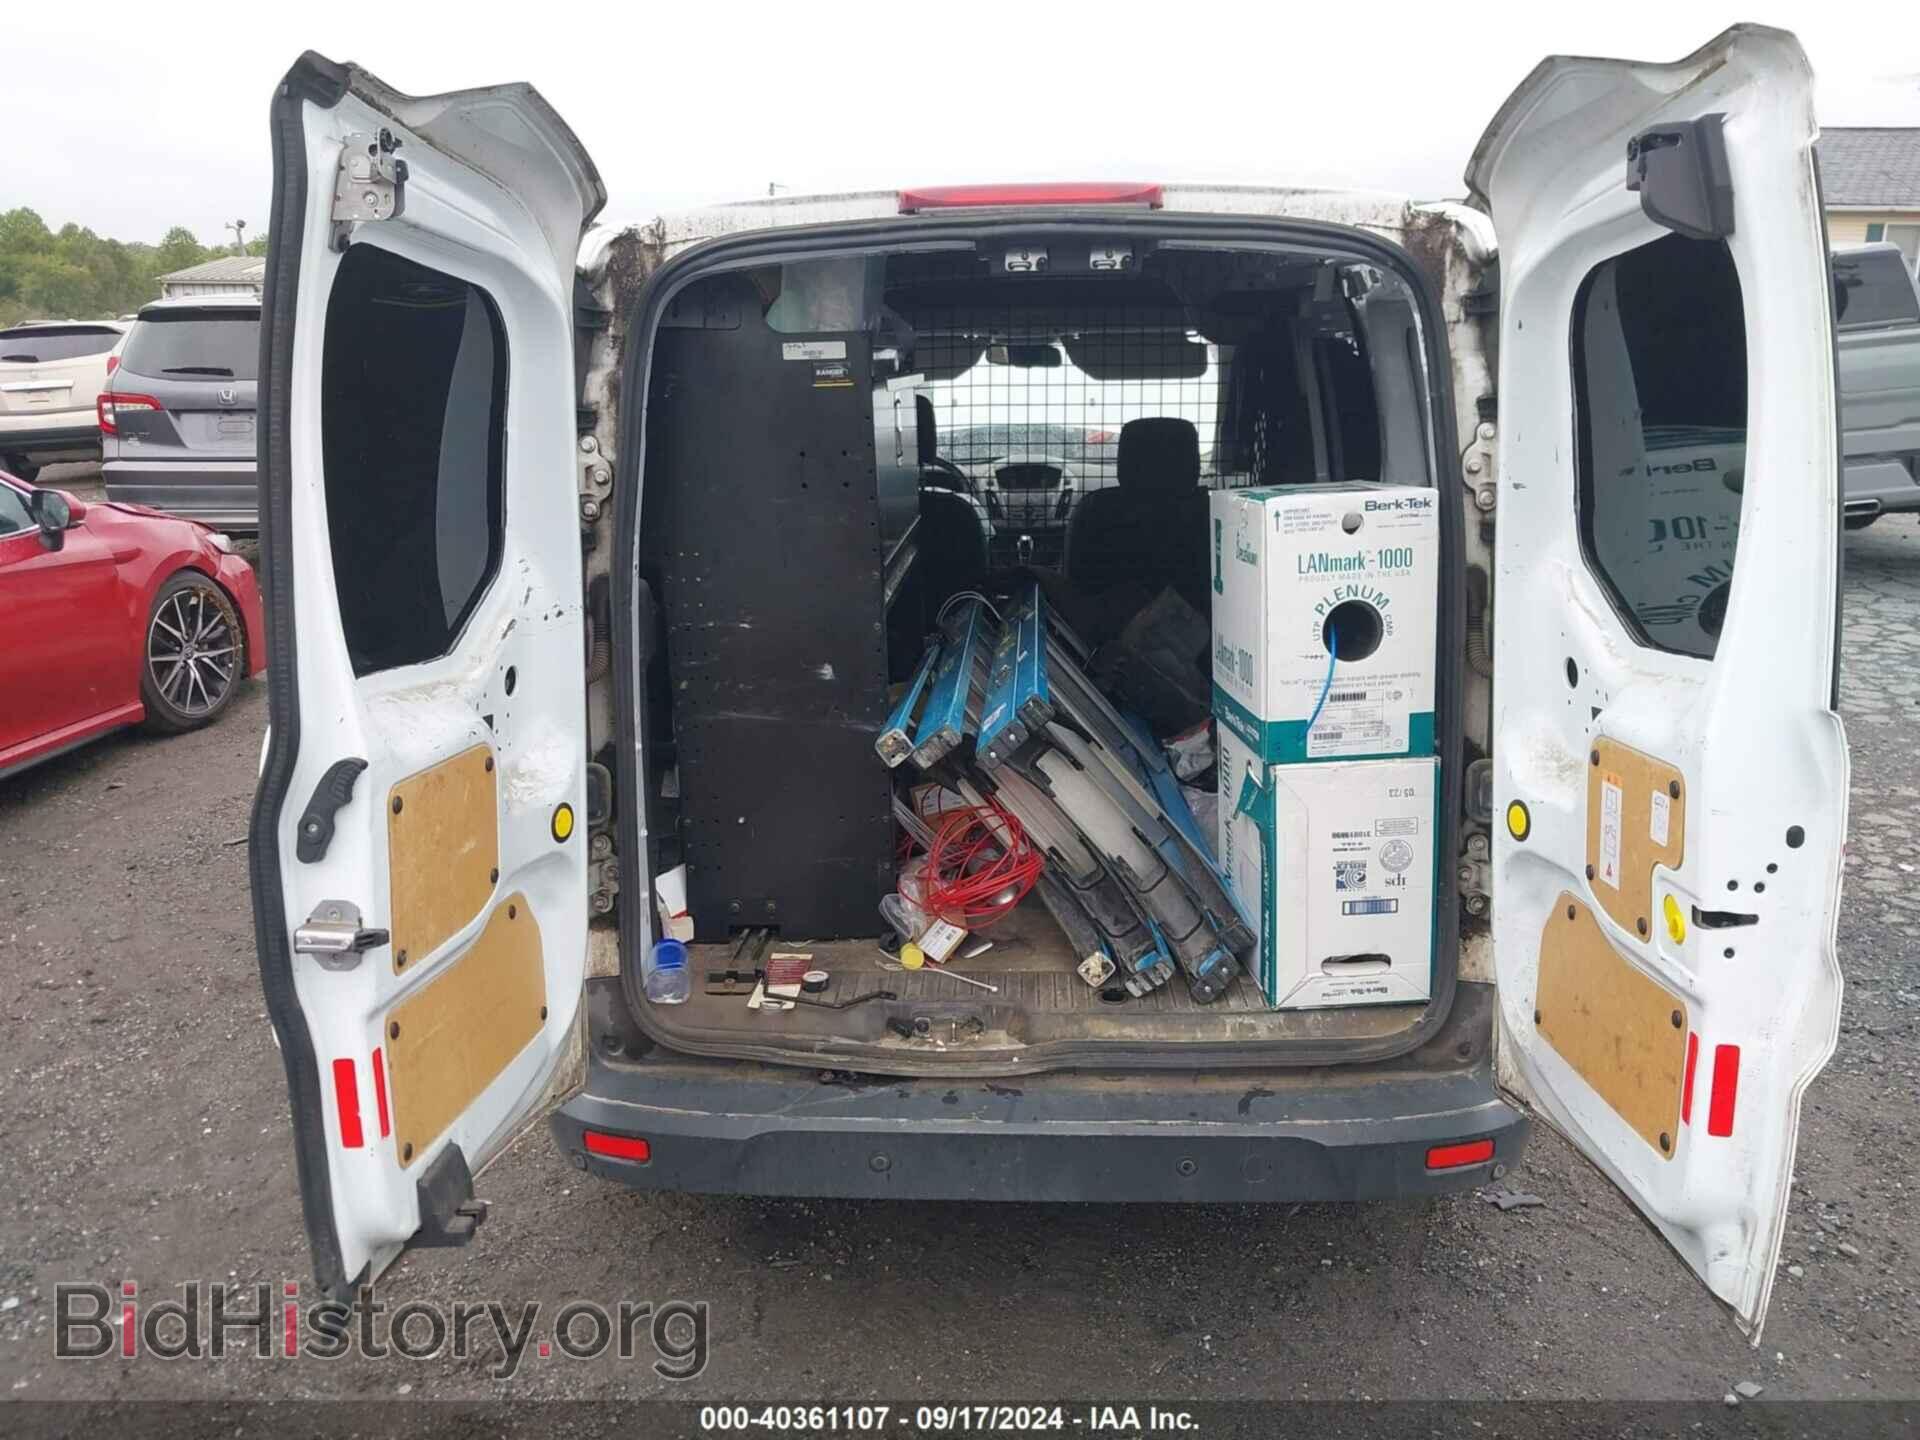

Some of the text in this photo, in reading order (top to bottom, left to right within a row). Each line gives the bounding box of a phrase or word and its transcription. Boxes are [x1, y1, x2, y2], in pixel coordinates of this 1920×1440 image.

[1365, 497, 1433, 512] Berk-Tek
[1315, 583, 1390, 616] PLENUM
[1312, 614, 1393, 642] UTP CMP
[1384, 873, 1407, 891] ips
